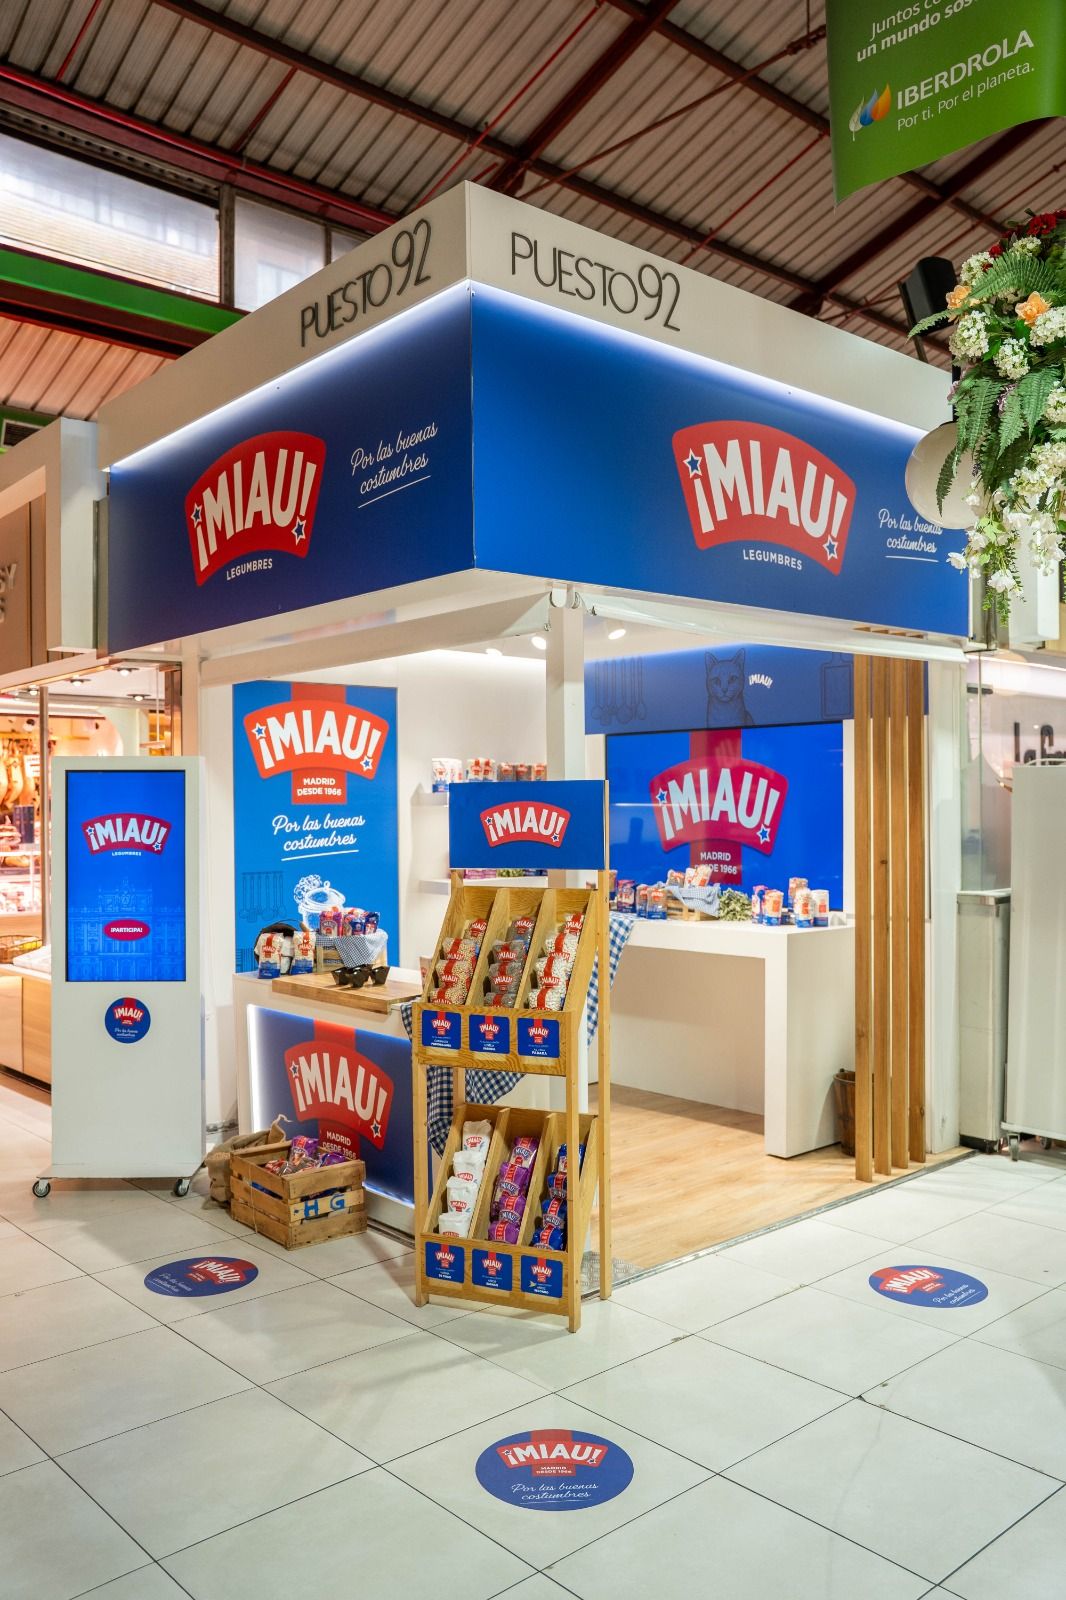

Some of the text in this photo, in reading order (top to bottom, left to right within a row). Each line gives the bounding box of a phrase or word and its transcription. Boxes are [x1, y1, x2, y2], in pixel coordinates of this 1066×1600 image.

[870, 4, 920, 41] Juntos
[857, 43, 877, 62] un
[881, 13, 940, 50] mundo
[897, 30, 1034, 110] IBERDROLA
[898, 63, 1035, 131] Por ti. Por el planeta.
[351, 422, 438, 476] Por las buenas
[360, 452, 428, 494] costumbres
[190, 448, 317, 572] ¡MIAU!
[683, 439, 848, 560] ¡MIAU!
[878, 508, 898, 528] Por
[900, 513, 913, 532] las
[886, 534, 938, 554] costumbres
[226, 558, 273, 580] LEGUMBRES
[742, 549, 802, 570] LEGUMBRES
[252, 709, 382, 771] ¡MIAU!
[297, 787, 342, 796] DESDE 1966
[303, 778, 336, 786] MADRID
[656, 768, 780, 844] ¡MIAU!
[86, 818, 167, 851] ¡MIAU!
[272, 814, 366, 836] Por las buenas
[485, 807, 564, 842] ¡MIAU!
[284, 831, 356, 852] costumbres
[700, 852, 731, 862] MADRID
[720, 864, 738, 875] 1966
[290, 1052, 388, 1138] ¡MIAU!
[326, 1130, 352, 1146] MADRID
[322, 1142, 356, 1160] DESDE 1966
[502, 1443, 602, 1465] ¡MIAU!
[512, 1484, 536, 1494] Por
[558, 1482, 599, 1490] buenas
[521, 1490, 592, 1500] costumbres
